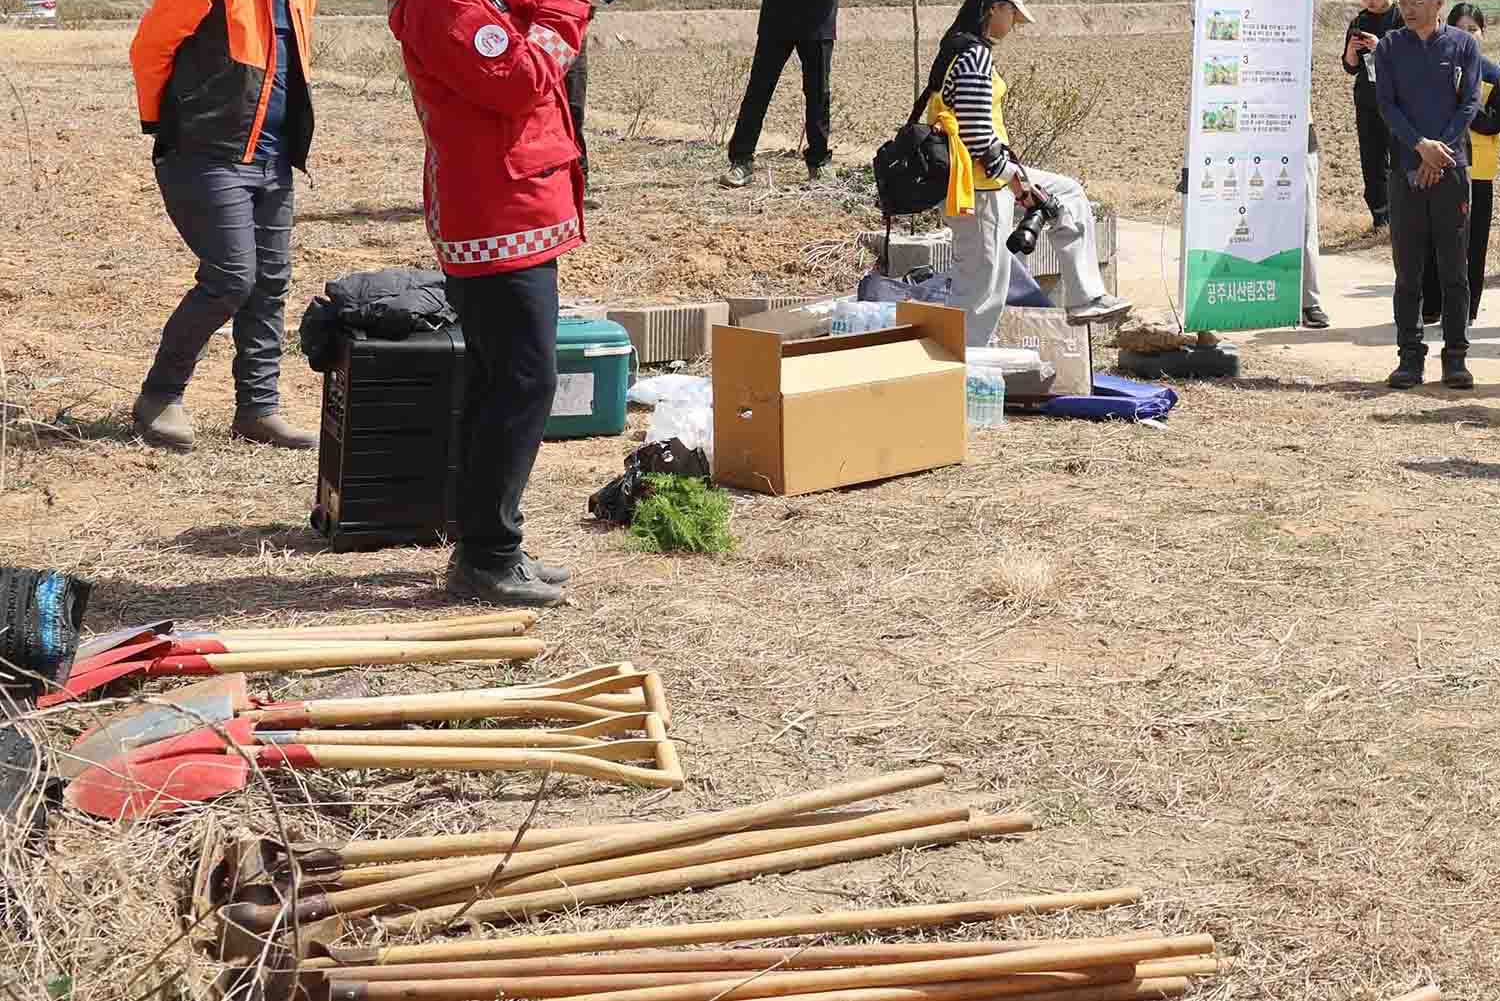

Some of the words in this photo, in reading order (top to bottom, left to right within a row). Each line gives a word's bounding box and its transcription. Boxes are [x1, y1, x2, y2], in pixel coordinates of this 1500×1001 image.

[1244, 9, 1250, 20] 2
[1242, 55, 1249, 65] 3
[1207, 280, 1276, 305] 공주시산림조합
